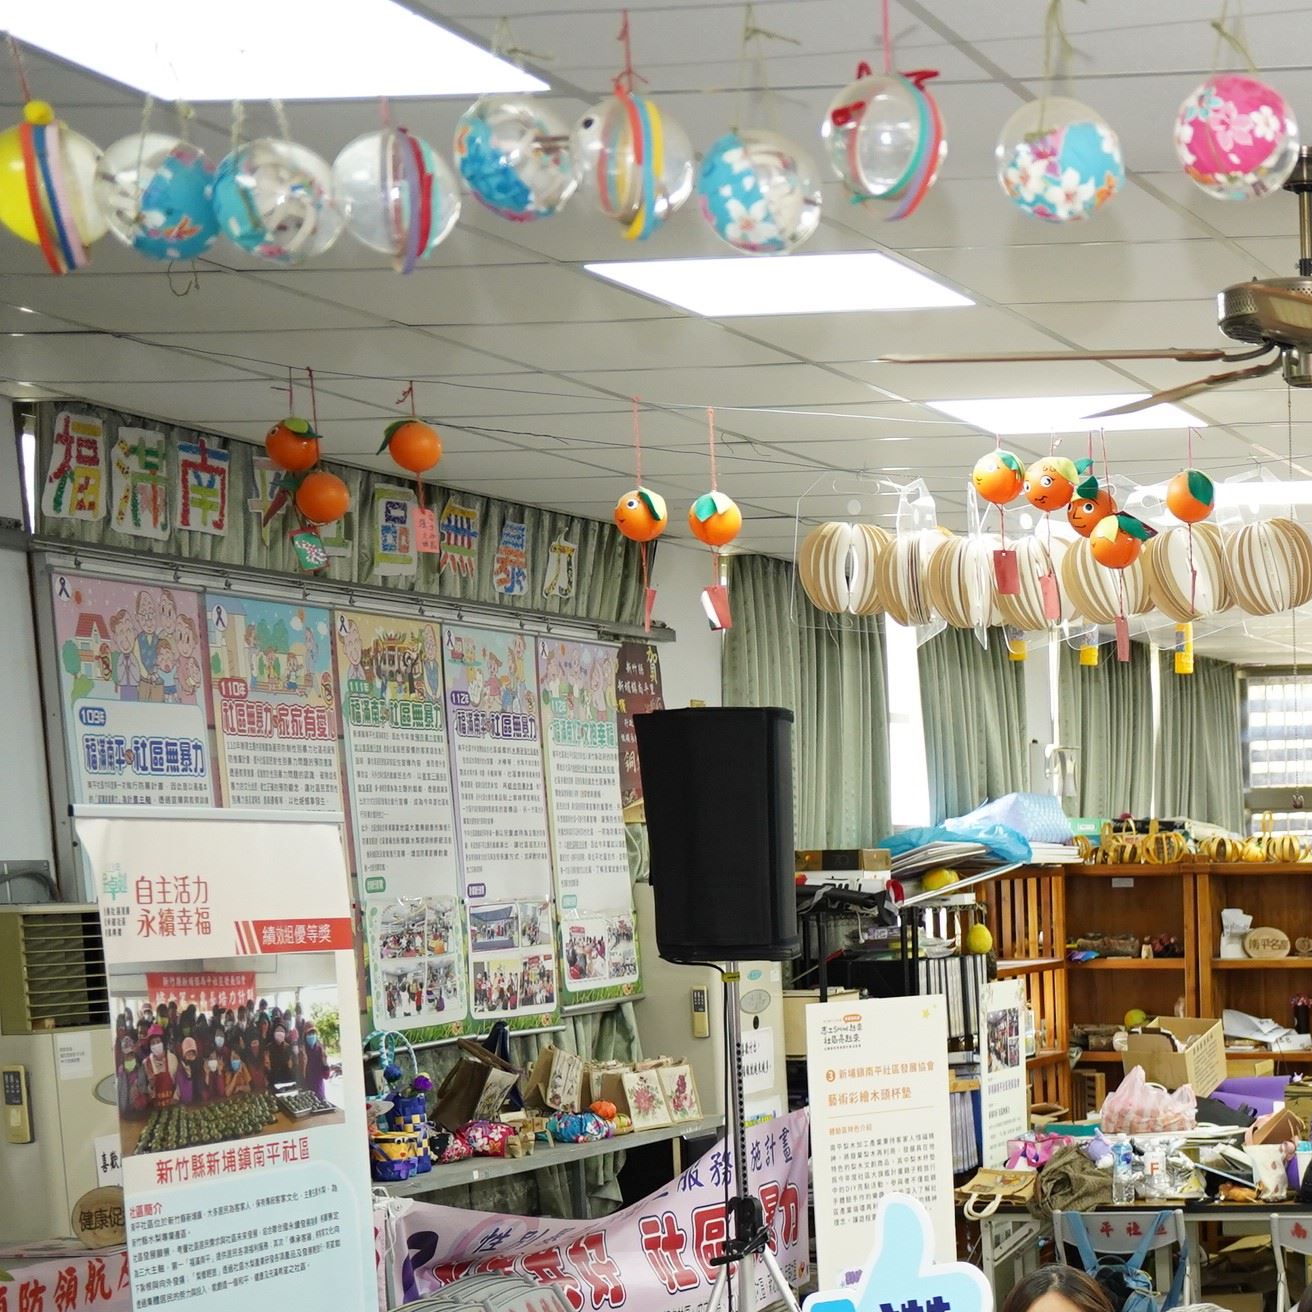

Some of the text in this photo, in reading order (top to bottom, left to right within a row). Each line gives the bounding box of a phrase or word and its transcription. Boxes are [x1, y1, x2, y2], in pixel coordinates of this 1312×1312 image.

[133, 738, 205, 775] 社區無暴力
[135, 875, 209, 905] 自主活力
[137, 906, 211, 938] 永續幸福
[262, 924, 332, 945] 績效組優等獎
[839, 1061, 935, 1079] 新埔鎮南平社區發展協會
[828, 1086, 912, 1107] 藝術彩繪木頭杯墊
[156, 1136, 310, 1185] 新竹縣新埔鎮南平社區
[1150, 1161, 1160, 1177] F
